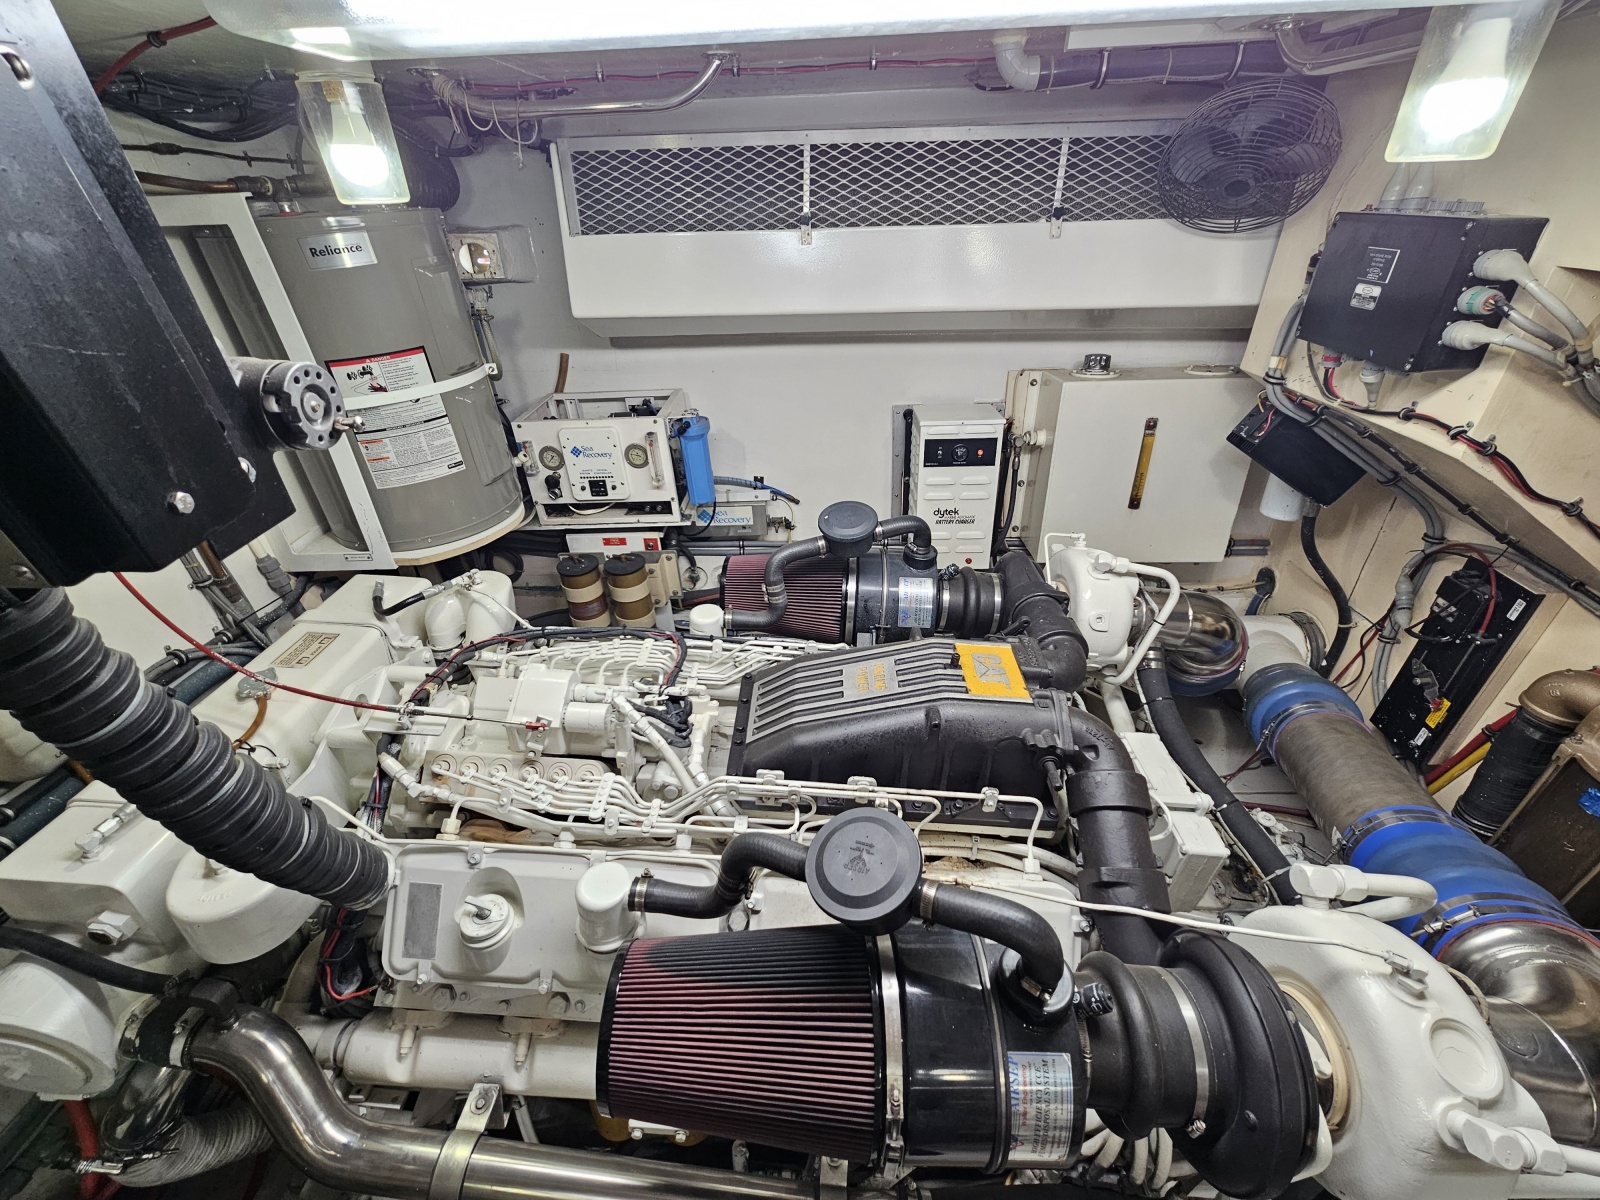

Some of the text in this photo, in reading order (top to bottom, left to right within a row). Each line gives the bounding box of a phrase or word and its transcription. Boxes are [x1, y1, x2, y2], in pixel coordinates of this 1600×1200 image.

[309, 244, 363, 258] Reliance
[370, 355, 391, 363] DANGER
[583, 451, 612, 459] Recovery
[933, 507, 959, 518] dytek
[713, 516, 751, 526] Recovery
[971, 652, 1012, 690] CAT
[1008, 1056, 1020, 1112] AIRSEP
[1021, 1064, 1029, 1104] Engieering
[1042, 1058, 1051, 1097] SYSTEM
